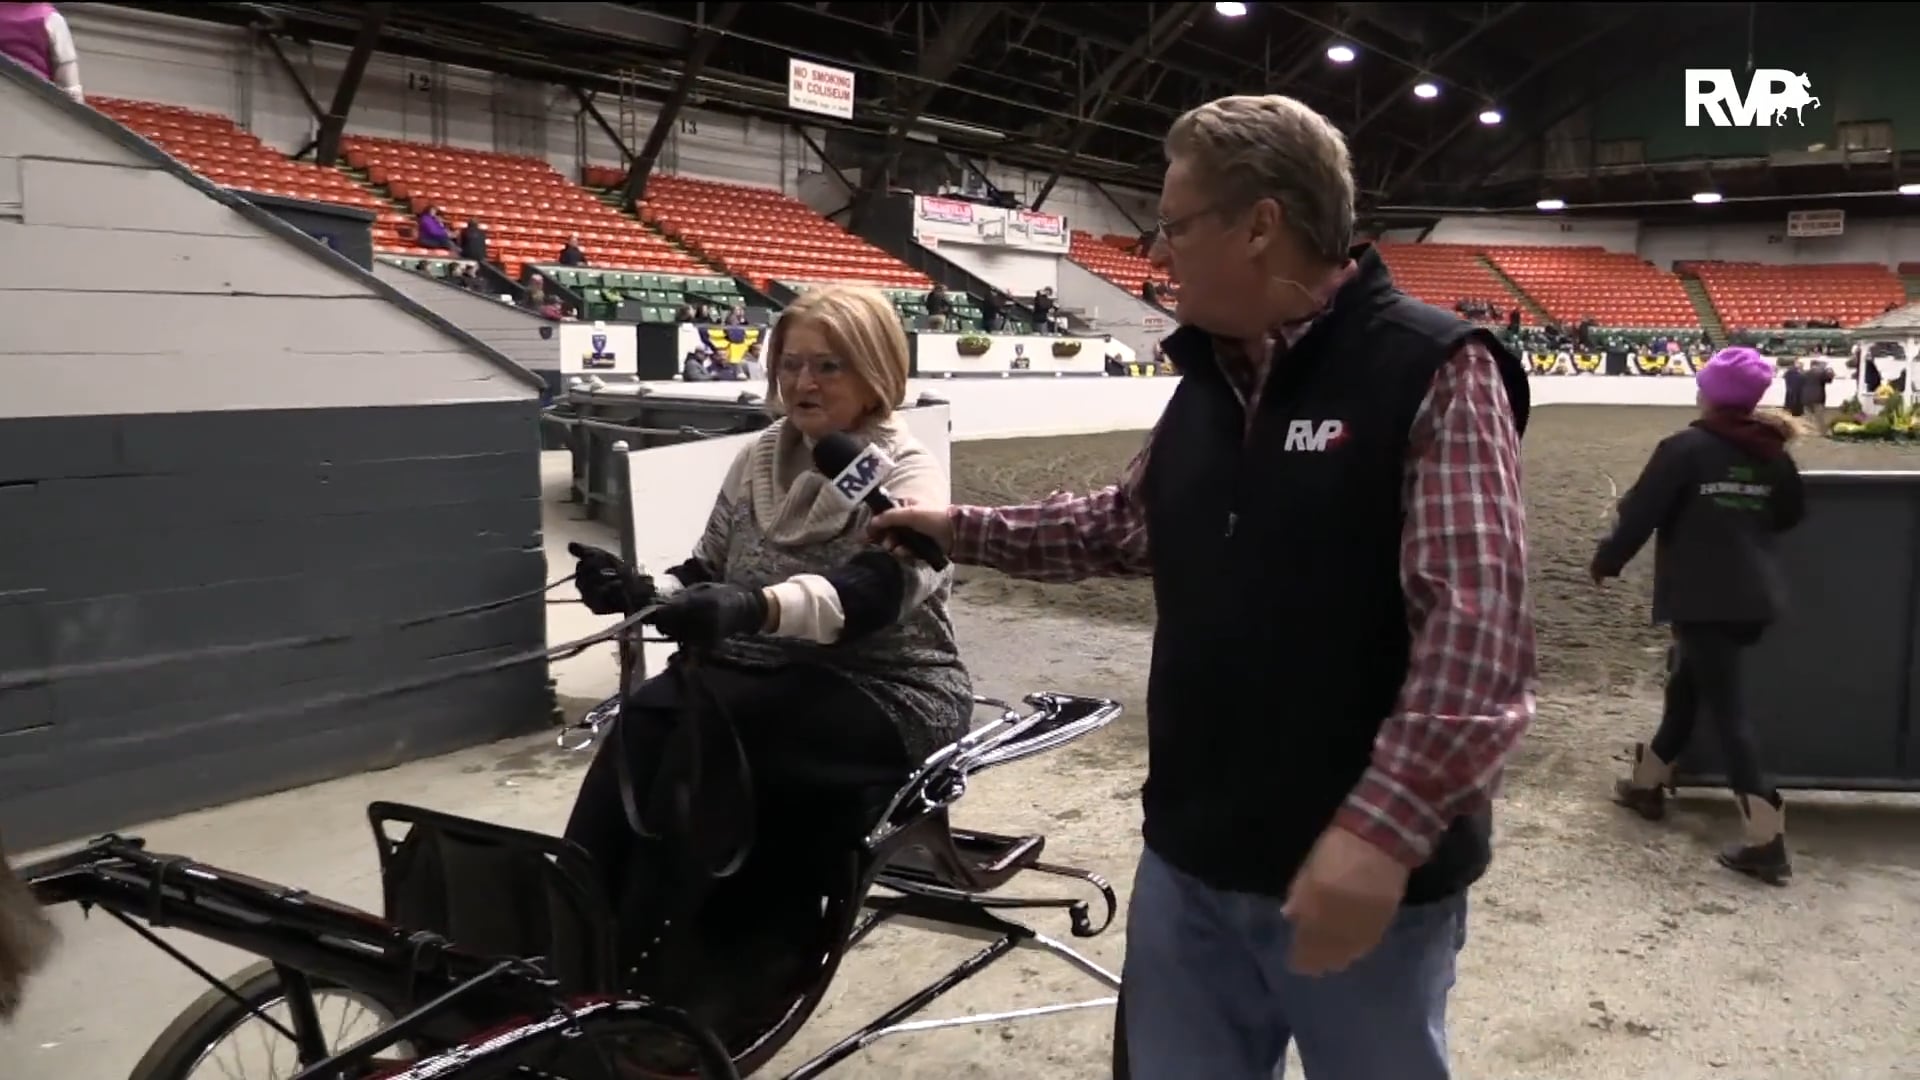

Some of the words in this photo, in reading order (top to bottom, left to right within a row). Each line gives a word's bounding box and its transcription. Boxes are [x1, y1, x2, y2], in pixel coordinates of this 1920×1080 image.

[409, 72, 430, 91] 12
[794, 66, 808, 79] NO
[812, 69, 851, 88] SMOKING
[793, 80, 803, 91] IN
[807, 82, 851, 101] COLISEUM
[681, 119, 697, 135] 13
[1284, 419, 1343, 451] RVP
[836, 454, 879, 500] RVP
